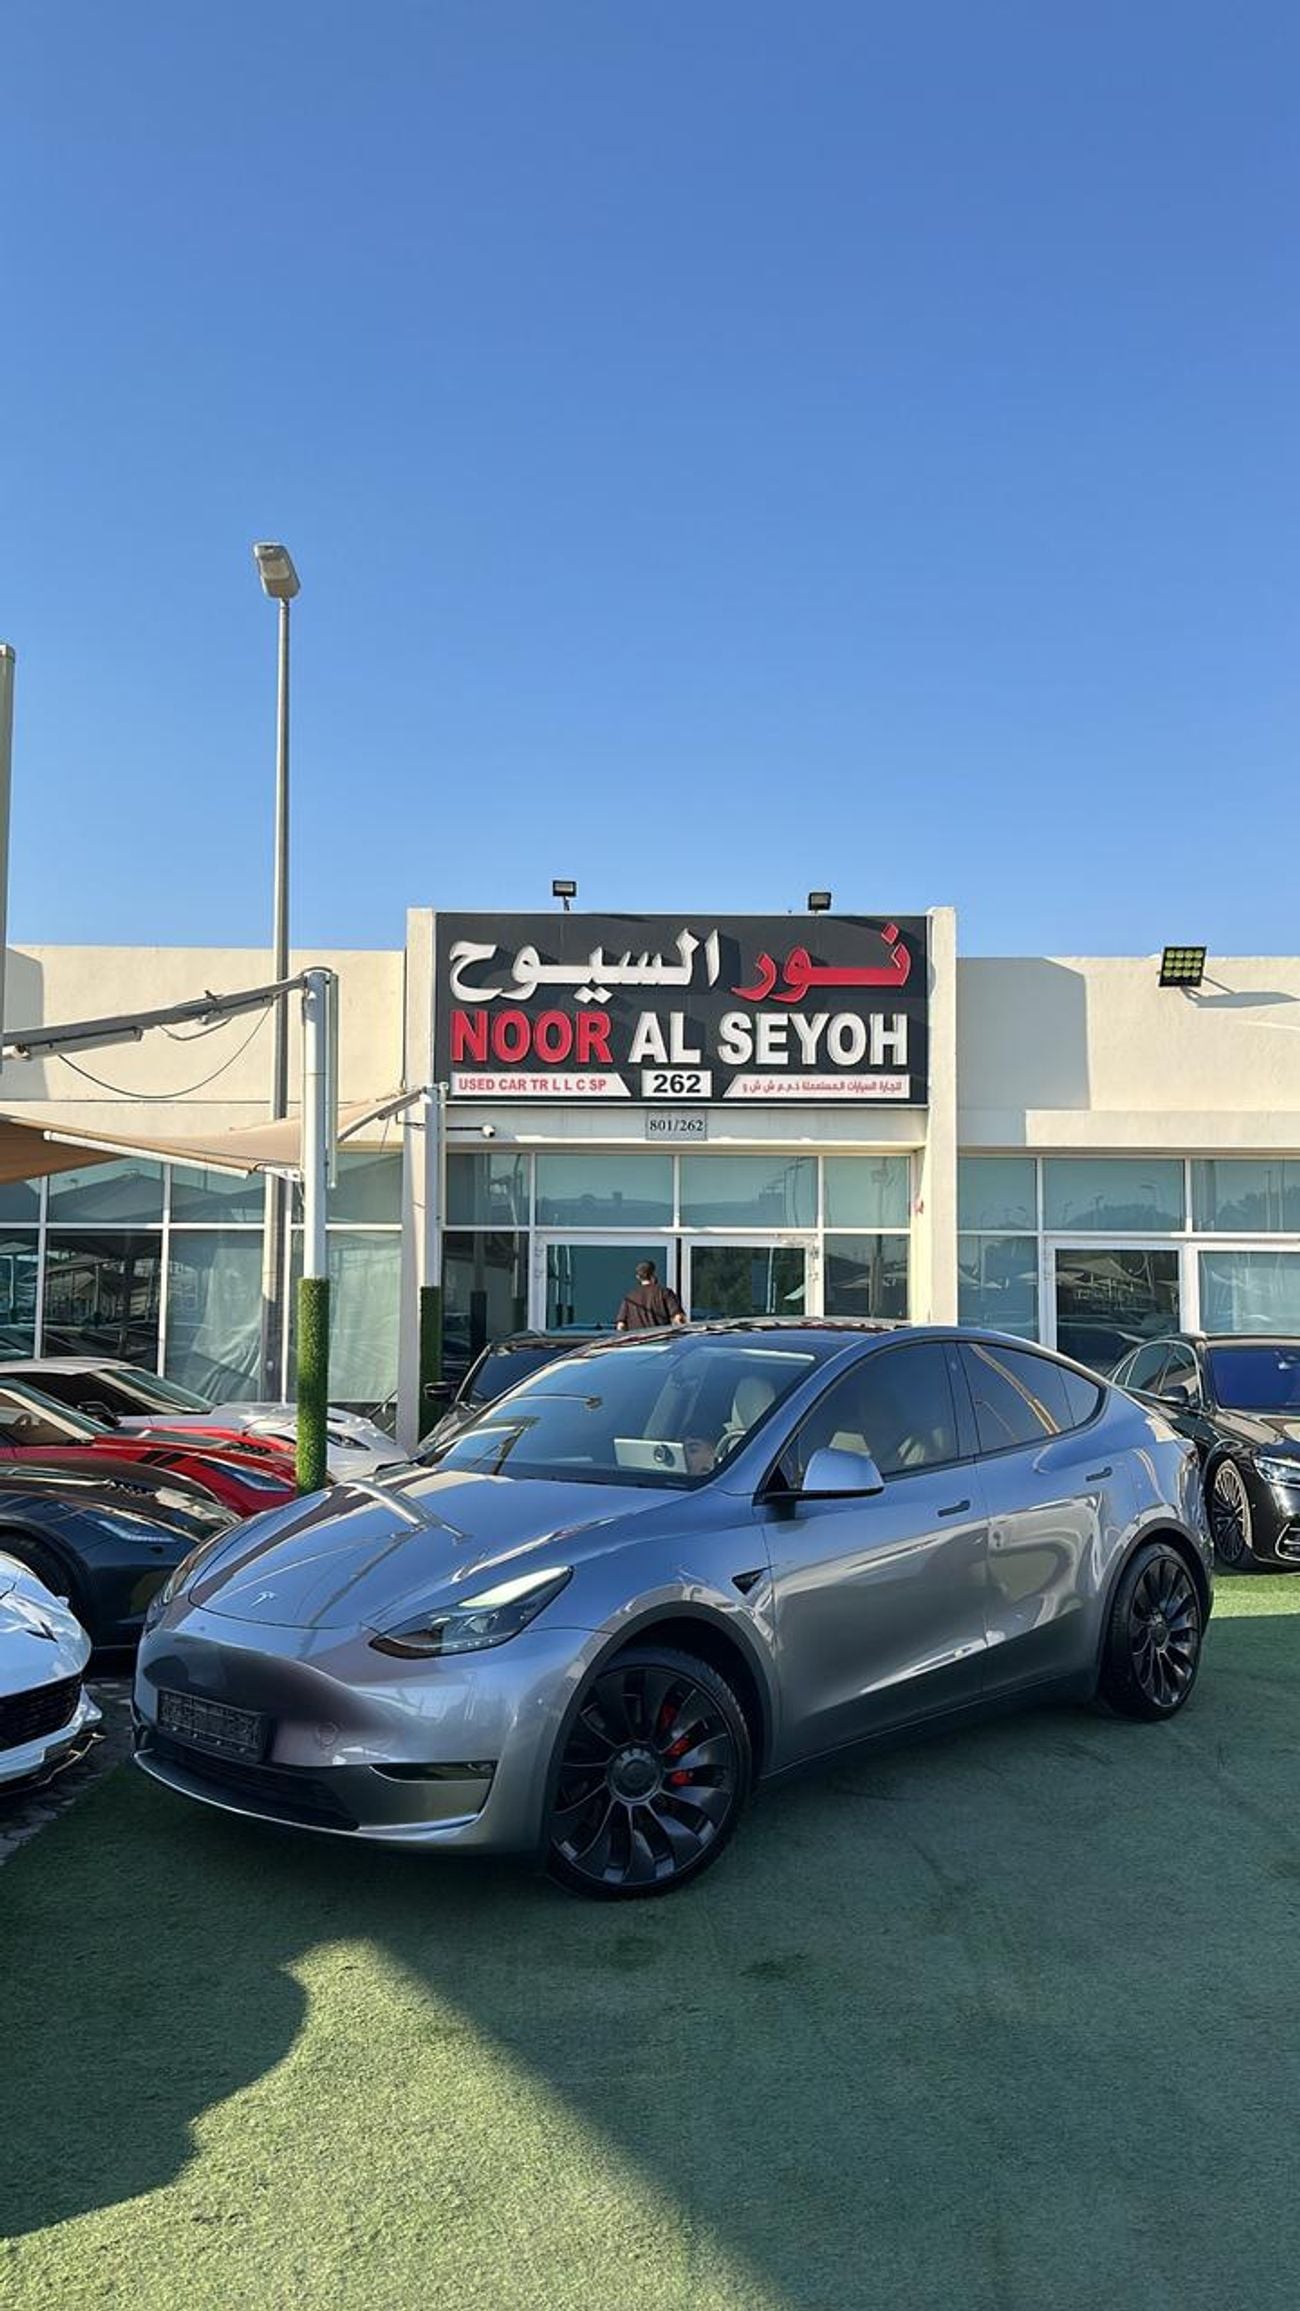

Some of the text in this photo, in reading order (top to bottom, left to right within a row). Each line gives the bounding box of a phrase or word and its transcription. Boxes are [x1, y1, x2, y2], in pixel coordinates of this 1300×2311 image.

[450, 923, 912, 1004] نور السيوح
[452, 1009, 908, 1065] NOOR AL SEYOH
[458, 1078, 495, 1091] USED
[499, 1078, 526, 1091] CAR
[529, 1078, 549, 1091] TR
[589, 1079, 606, 1091] SP
[653, 1074, 701, 1094] 262
[649, 1120, 704, 1132] 801/262
